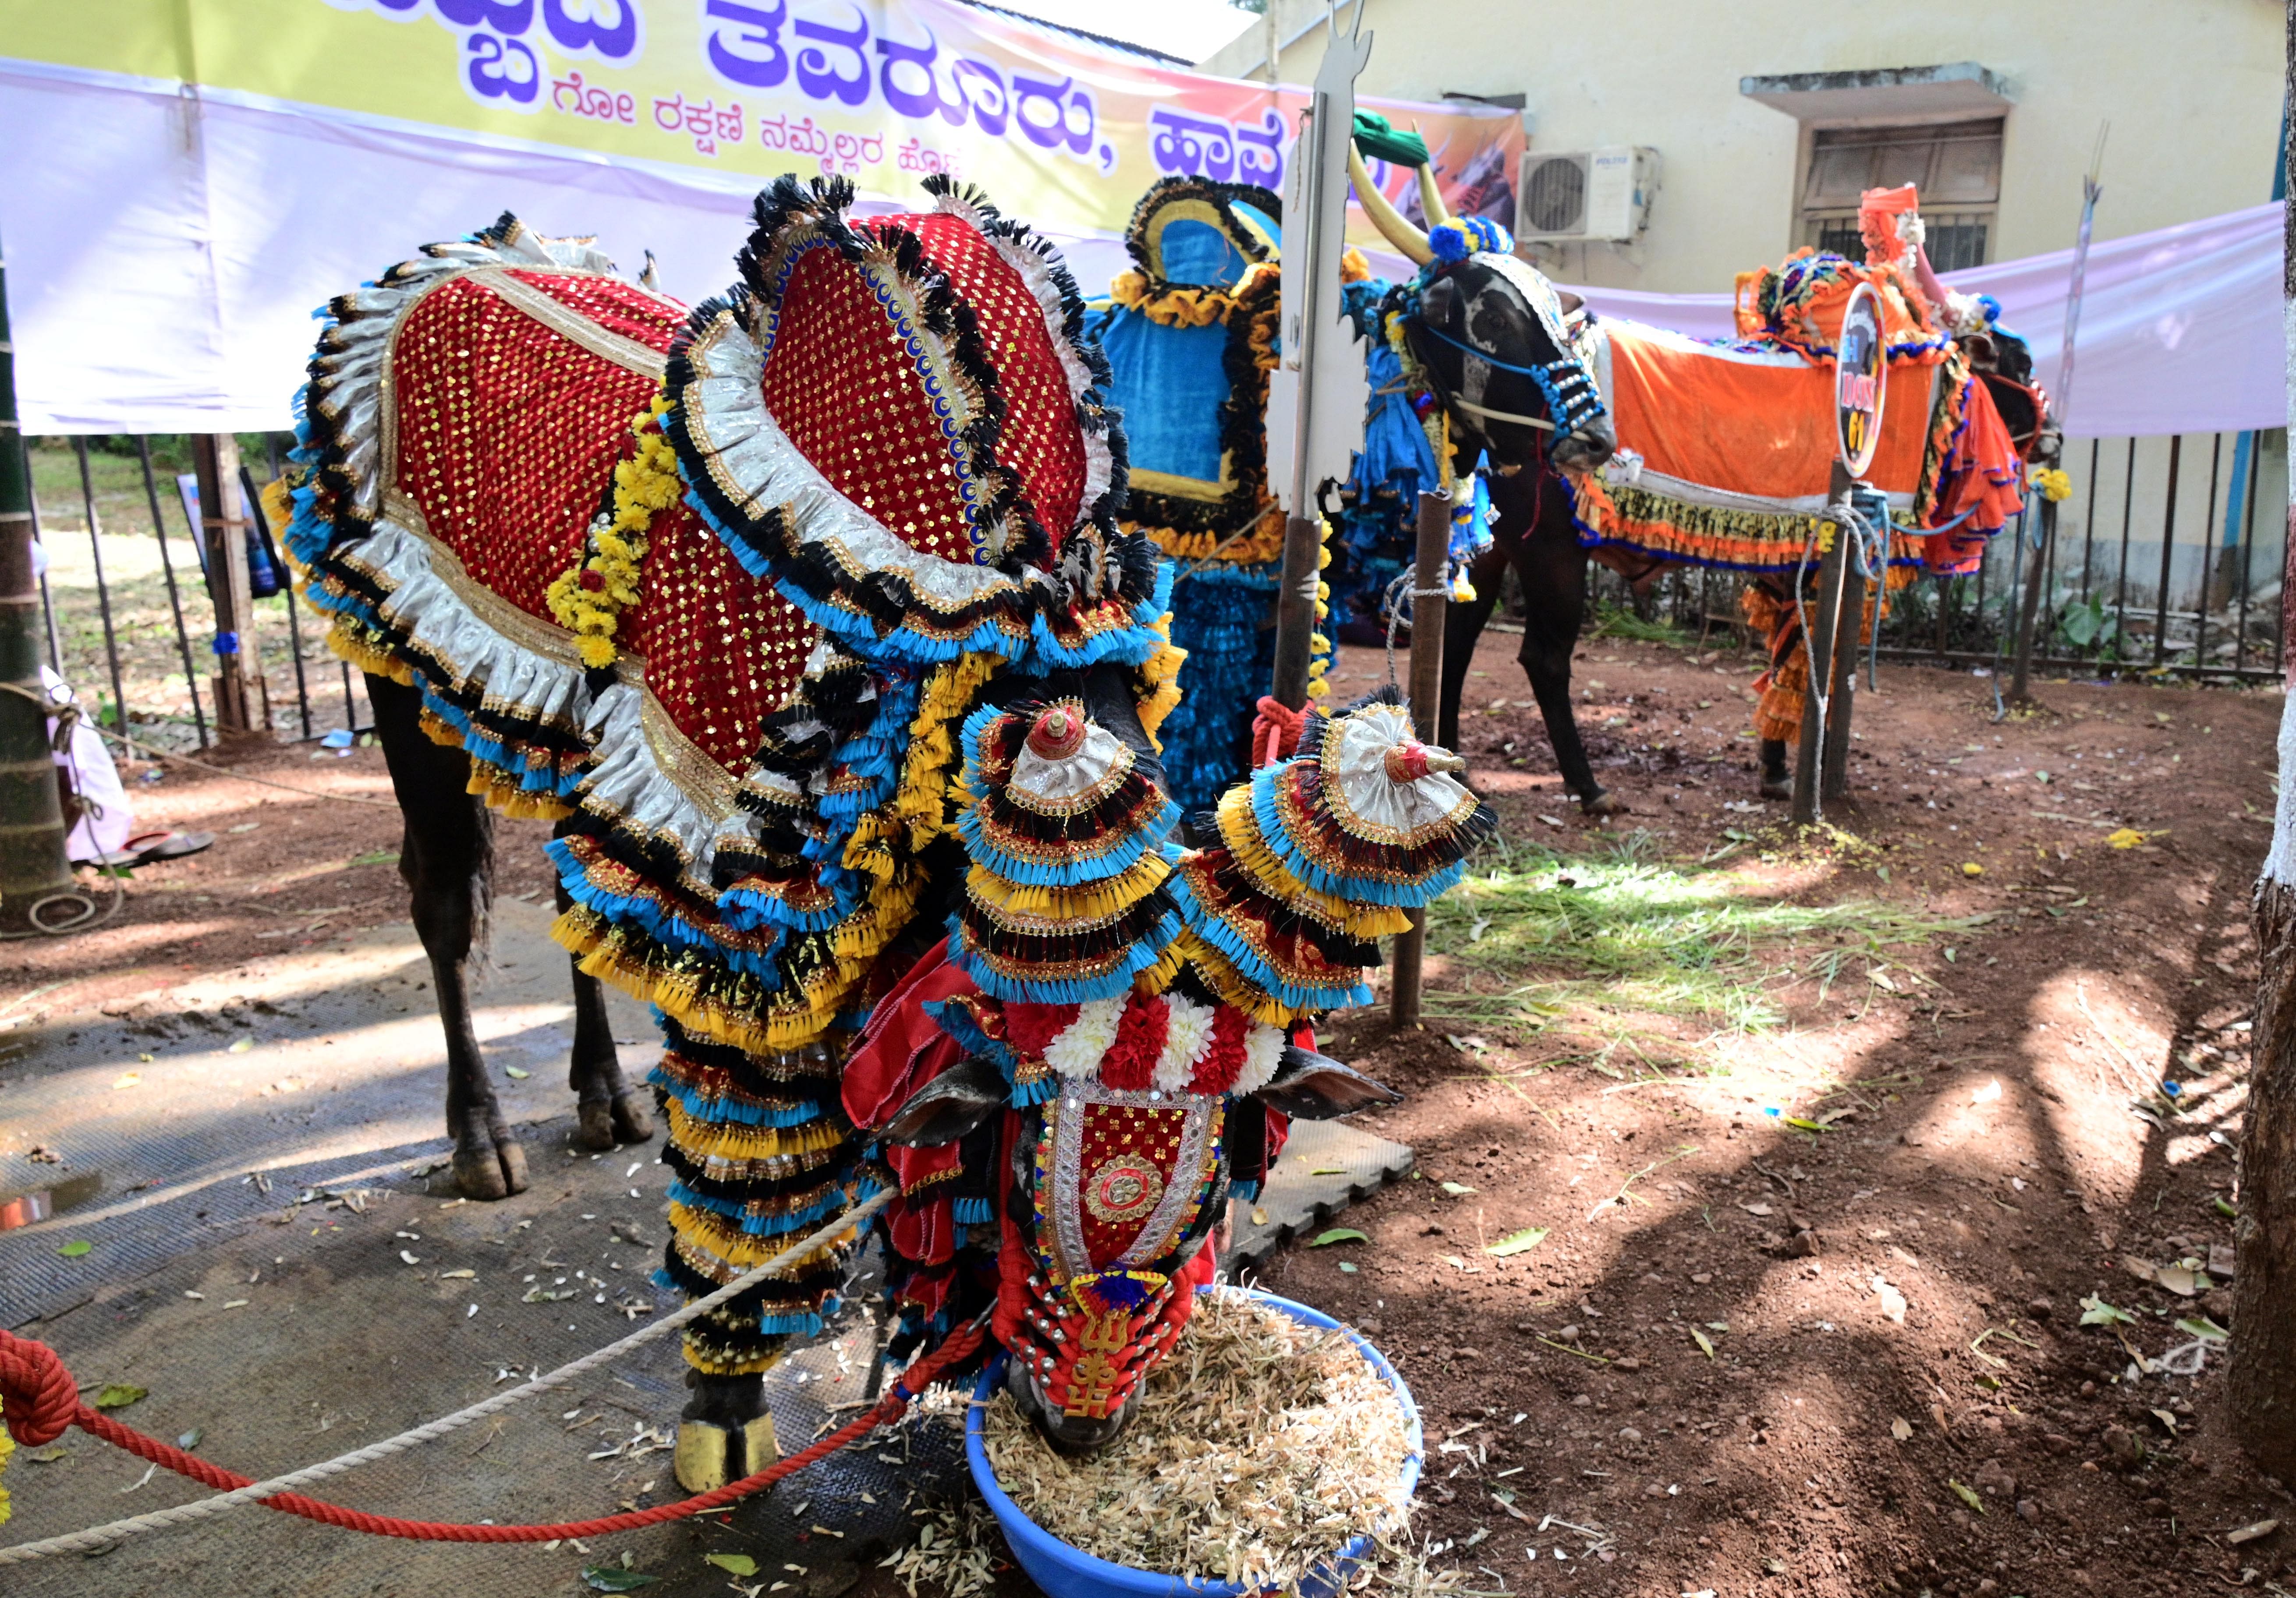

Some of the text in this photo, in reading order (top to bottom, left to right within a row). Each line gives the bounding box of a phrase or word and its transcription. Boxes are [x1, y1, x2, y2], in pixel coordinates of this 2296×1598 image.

[553, 73, 634, 124] ಗೋ
[654, 94, 744, 155] ರಕ್ಷಣೆ
[706, 0, 1113, 170] ತವರೂರು,
[1842, 371, 1876, 412] DON
[1849, 411, 1864, 451] 61
